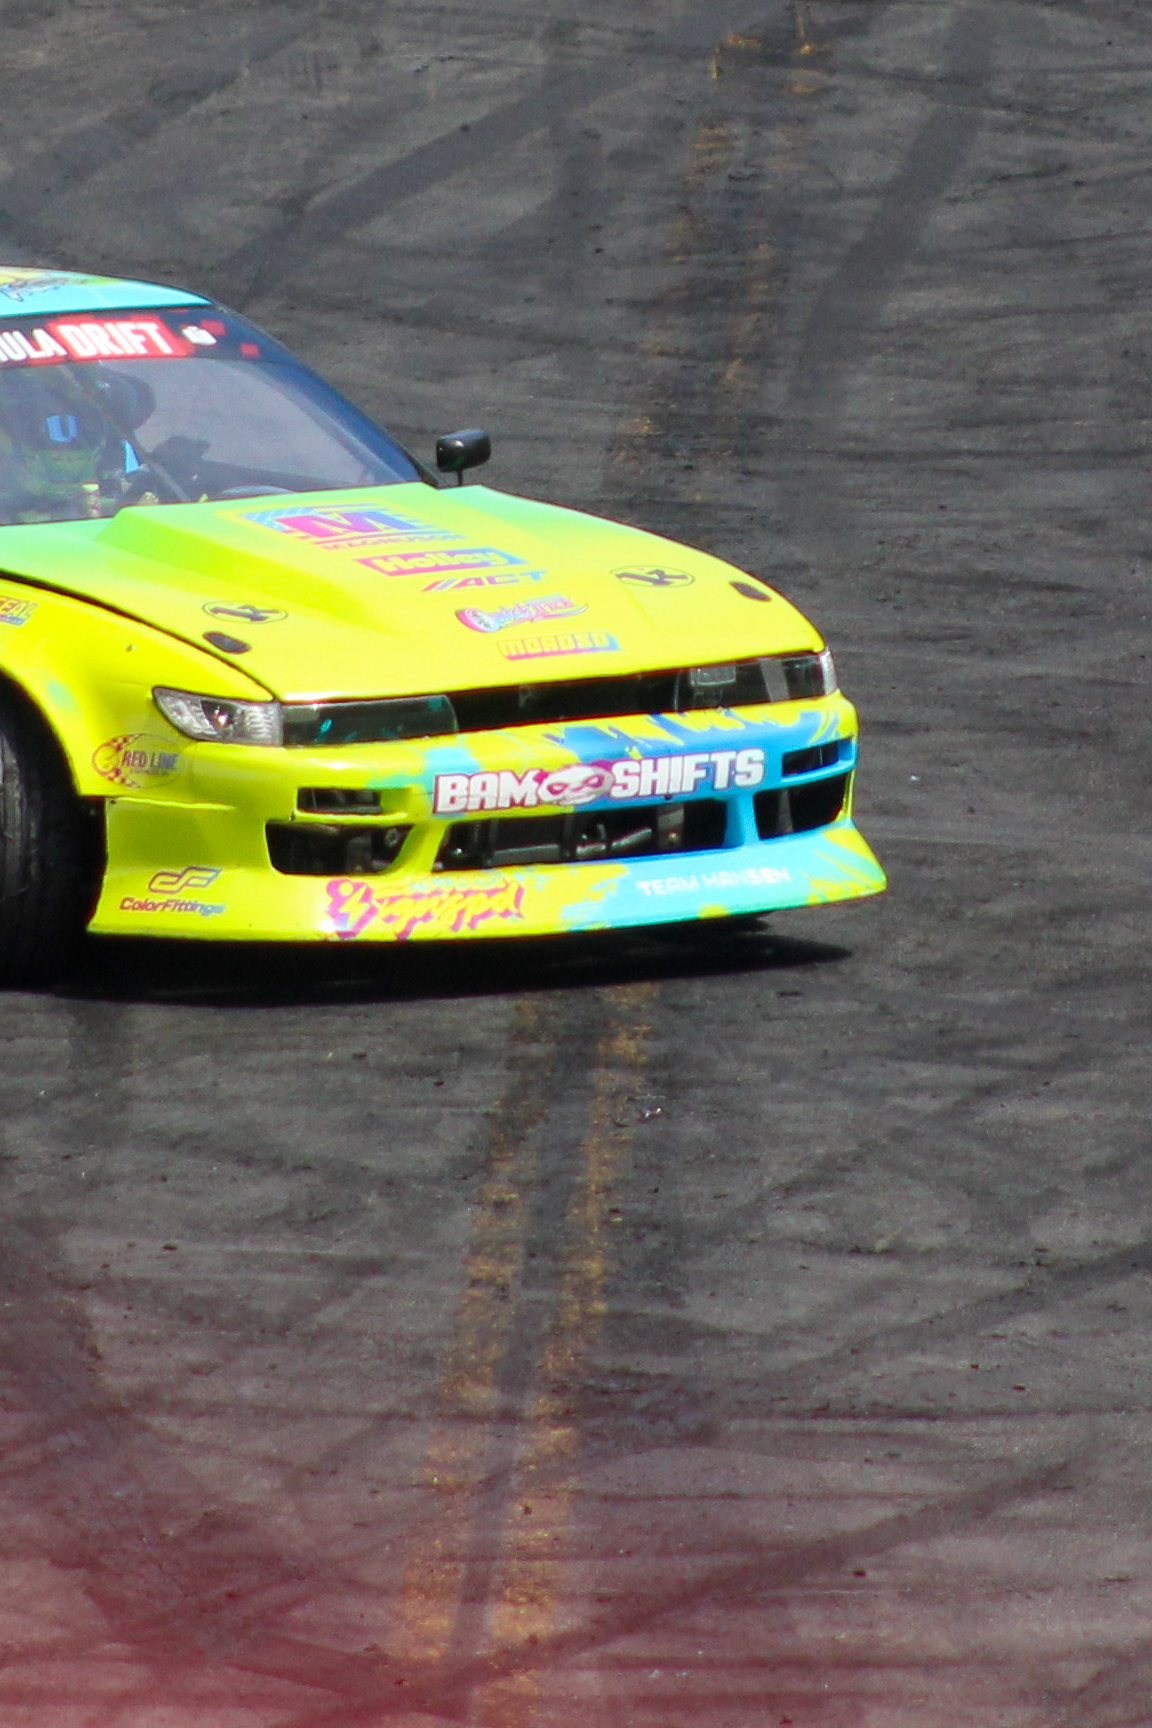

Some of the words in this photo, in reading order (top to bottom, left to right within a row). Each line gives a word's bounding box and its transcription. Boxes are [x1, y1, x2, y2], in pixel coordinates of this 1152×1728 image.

[63, 321, 173, 358] DRIFT
[370, 550, 509, 572] Holley
[499, 632, 609, 656] MOROSO
[122, 751, 148, 768] RED
[150, 752, 179, 769] LINE
[434, 769, 544, 813] BAM
[612, 748, 764, 799] SHIFTS
[636, 875, 699, 897] TEAM
[706, 866, 791, 890] HANSEN
[119, 897, 225, 916] ColorFittings
